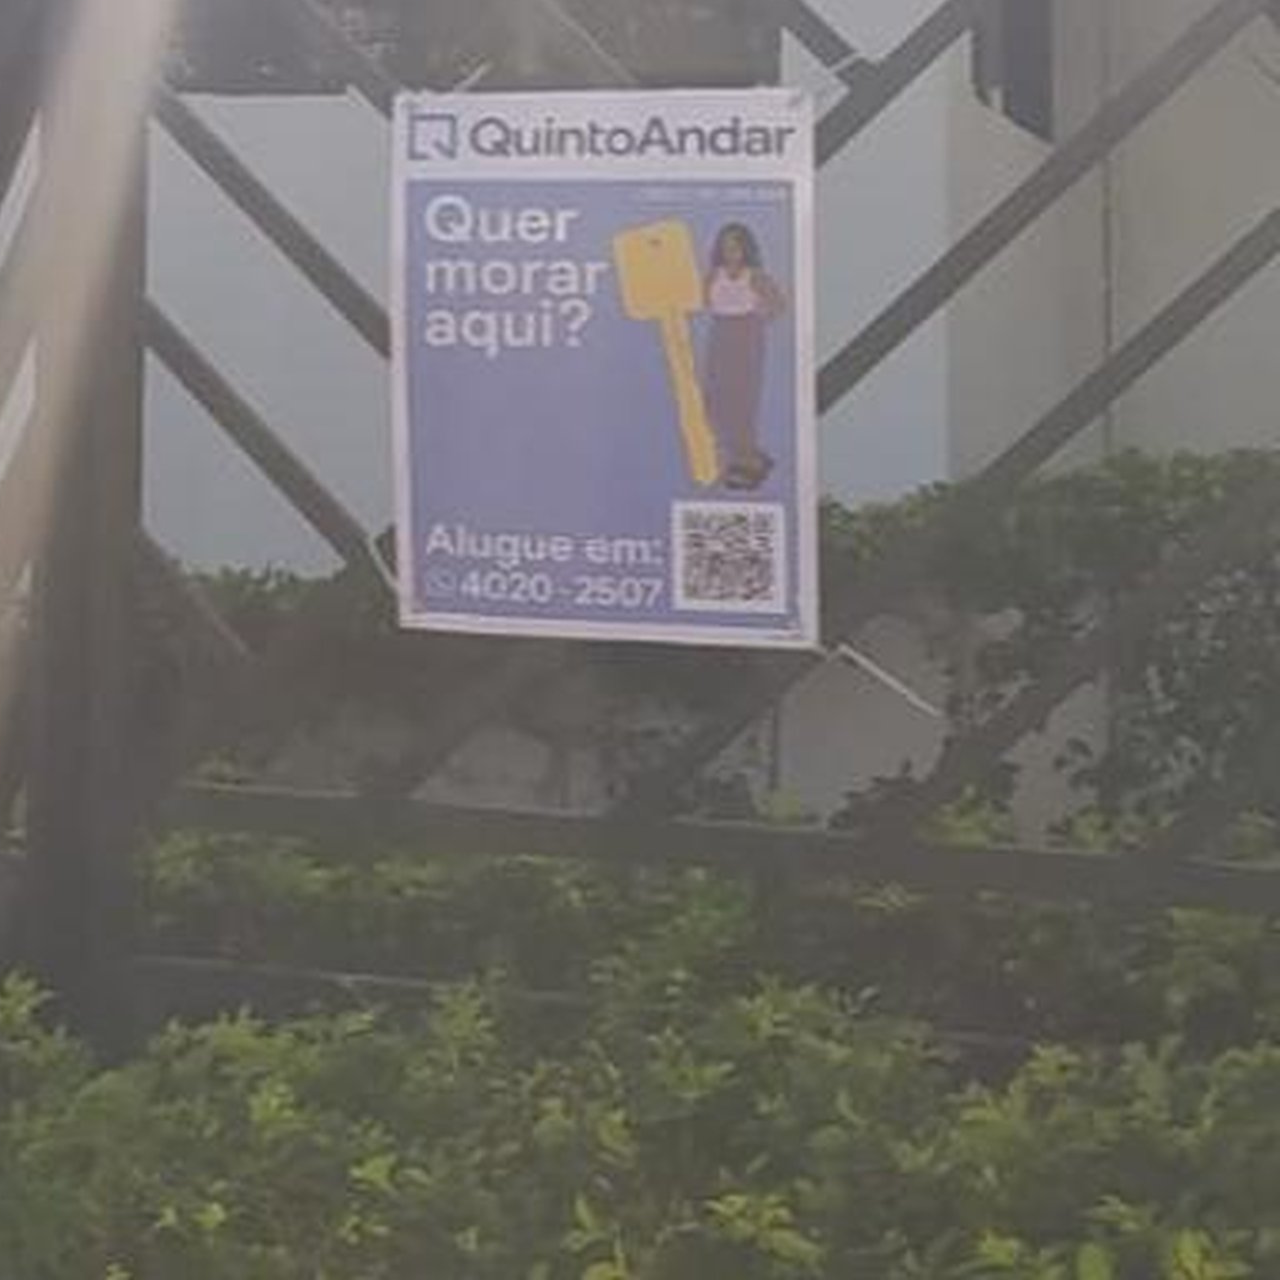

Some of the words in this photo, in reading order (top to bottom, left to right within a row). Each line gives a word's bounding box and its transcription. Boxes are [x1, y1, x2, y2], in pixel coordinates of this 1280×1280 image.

[469, 116, 797, 158] QuintoAndar
[424, 195, 579, 243] Quer
[424, 257, 610, 296] morar
[424, 300, 593, 358] aqui?
[426, 524, 574, 571] Alugue
[586, 534, 665, 567] em:
